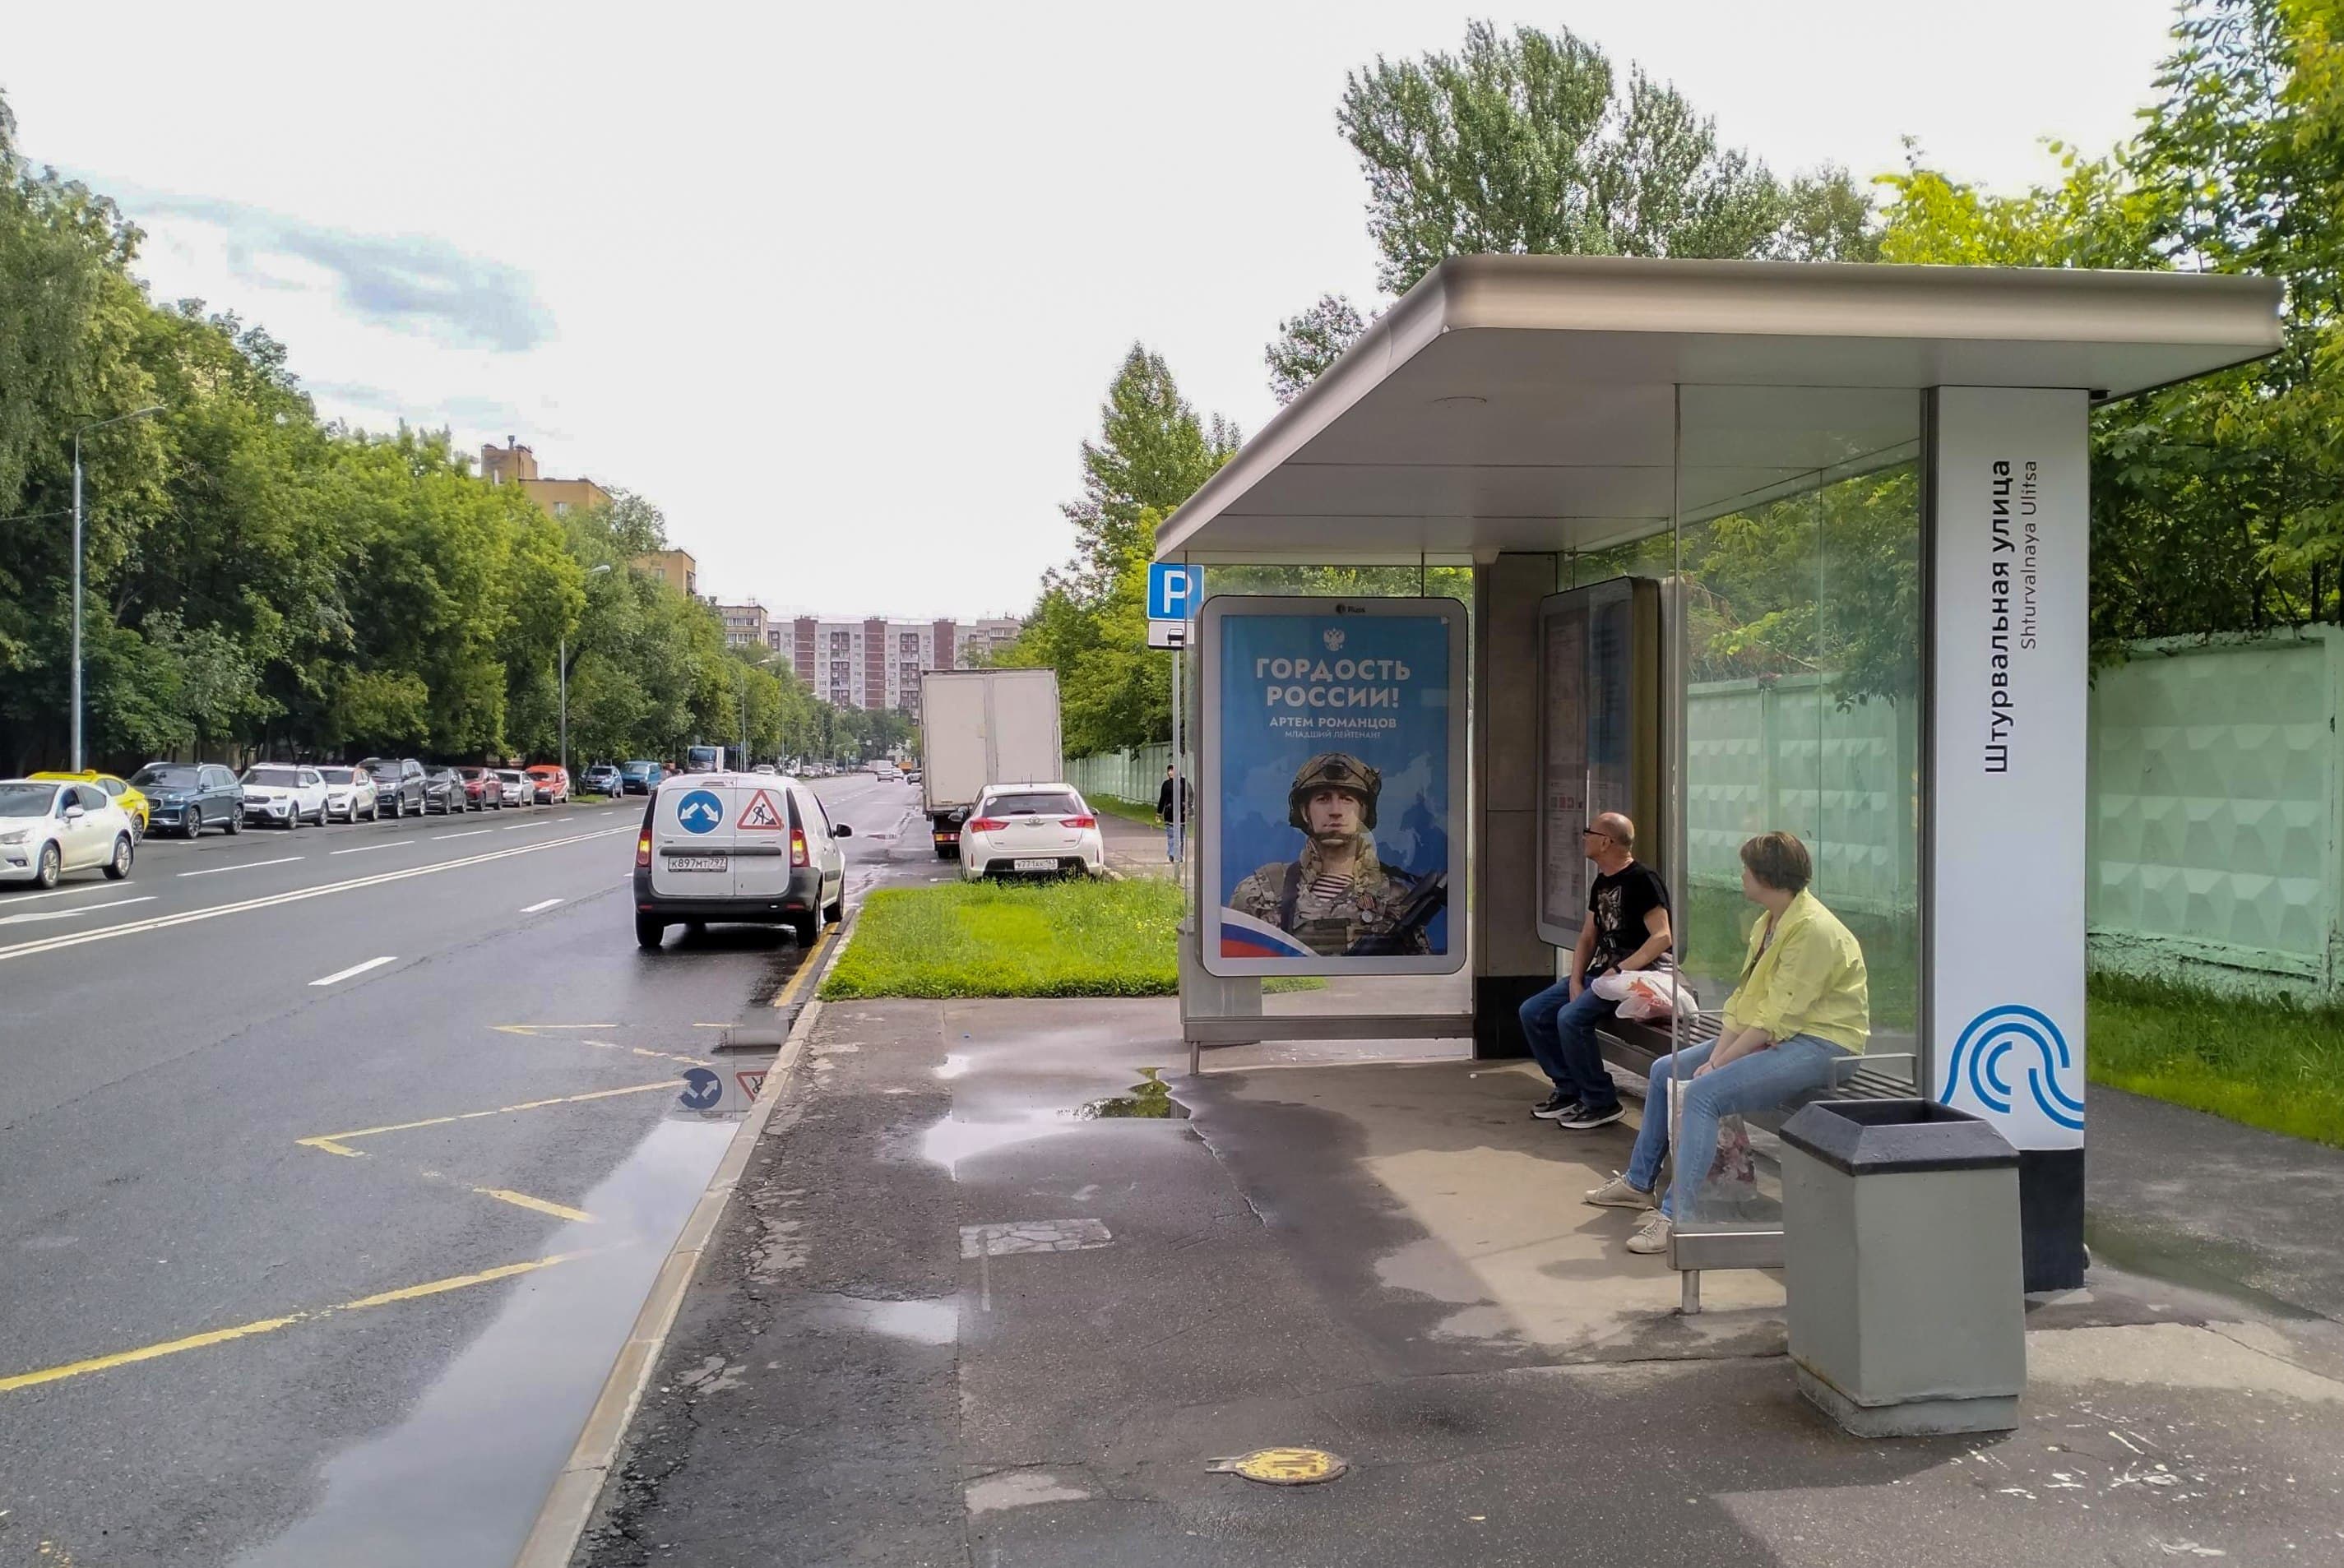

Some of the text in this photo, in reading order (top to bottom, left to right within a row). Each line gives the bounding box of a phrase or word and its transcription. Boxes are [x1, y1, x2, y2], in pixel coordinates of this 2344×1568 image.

[2020, 460, 2040, 650] Shturvalnaya Ulitsa
[1163, 570, 1193, 614] P
[1985, 460, 2015, 773] Штурвальная улица
[1256, 658, 1411, 682] ГОРДОСТЬ
[1267, 686, 1400, 708] РОССИИ!
[1269, 716, 1397, 729] АРТЕМ РОМАНЦОВ
[1285, 729, 1332, 738] МЛАДШИЙ
